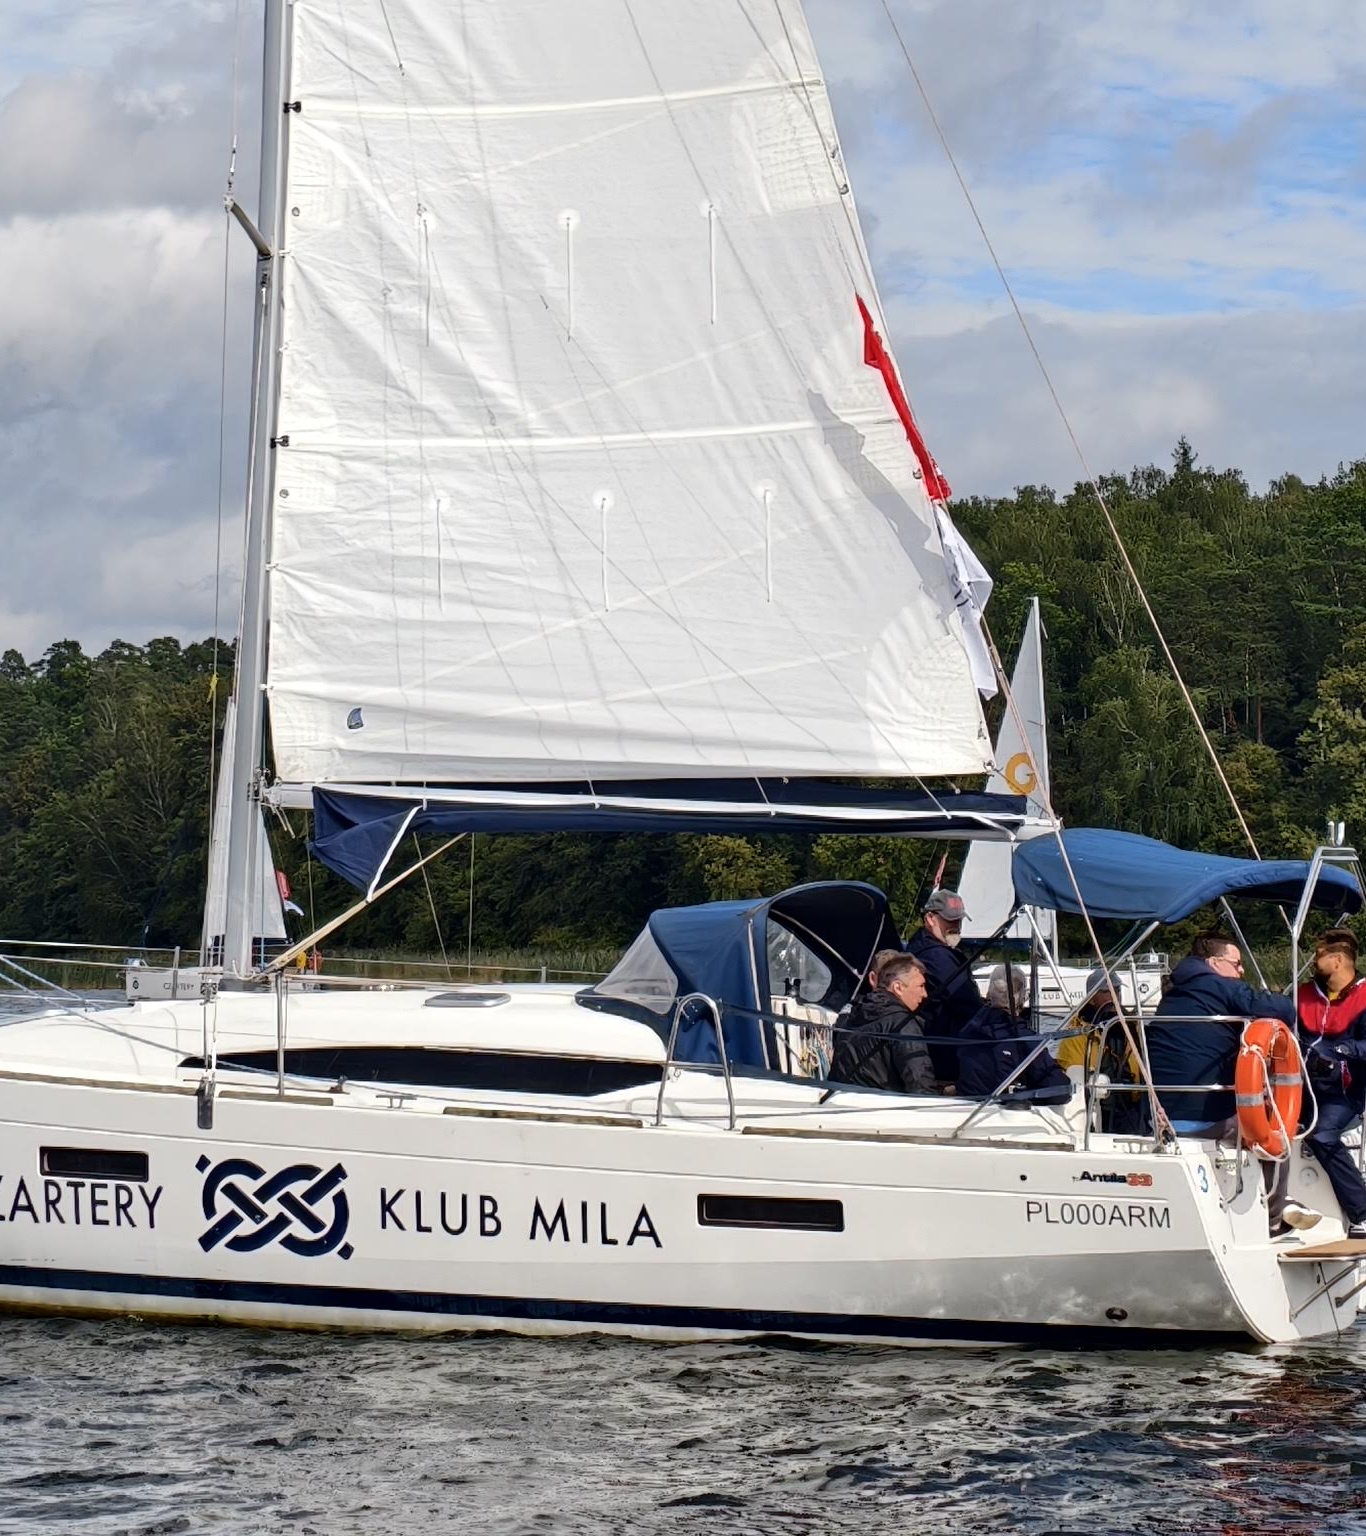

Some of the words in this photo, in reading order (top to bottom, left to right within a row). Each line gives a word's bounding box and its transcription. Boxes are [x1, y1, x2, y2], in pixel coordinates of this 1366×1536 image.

[1197, 1164, 1208, 1193] 3
[380, 1187, 502, 1237] KLUB
[529, 1195, 663, 1248] MILA
[1026, 1201, 1171, 1228] PL000ARM
